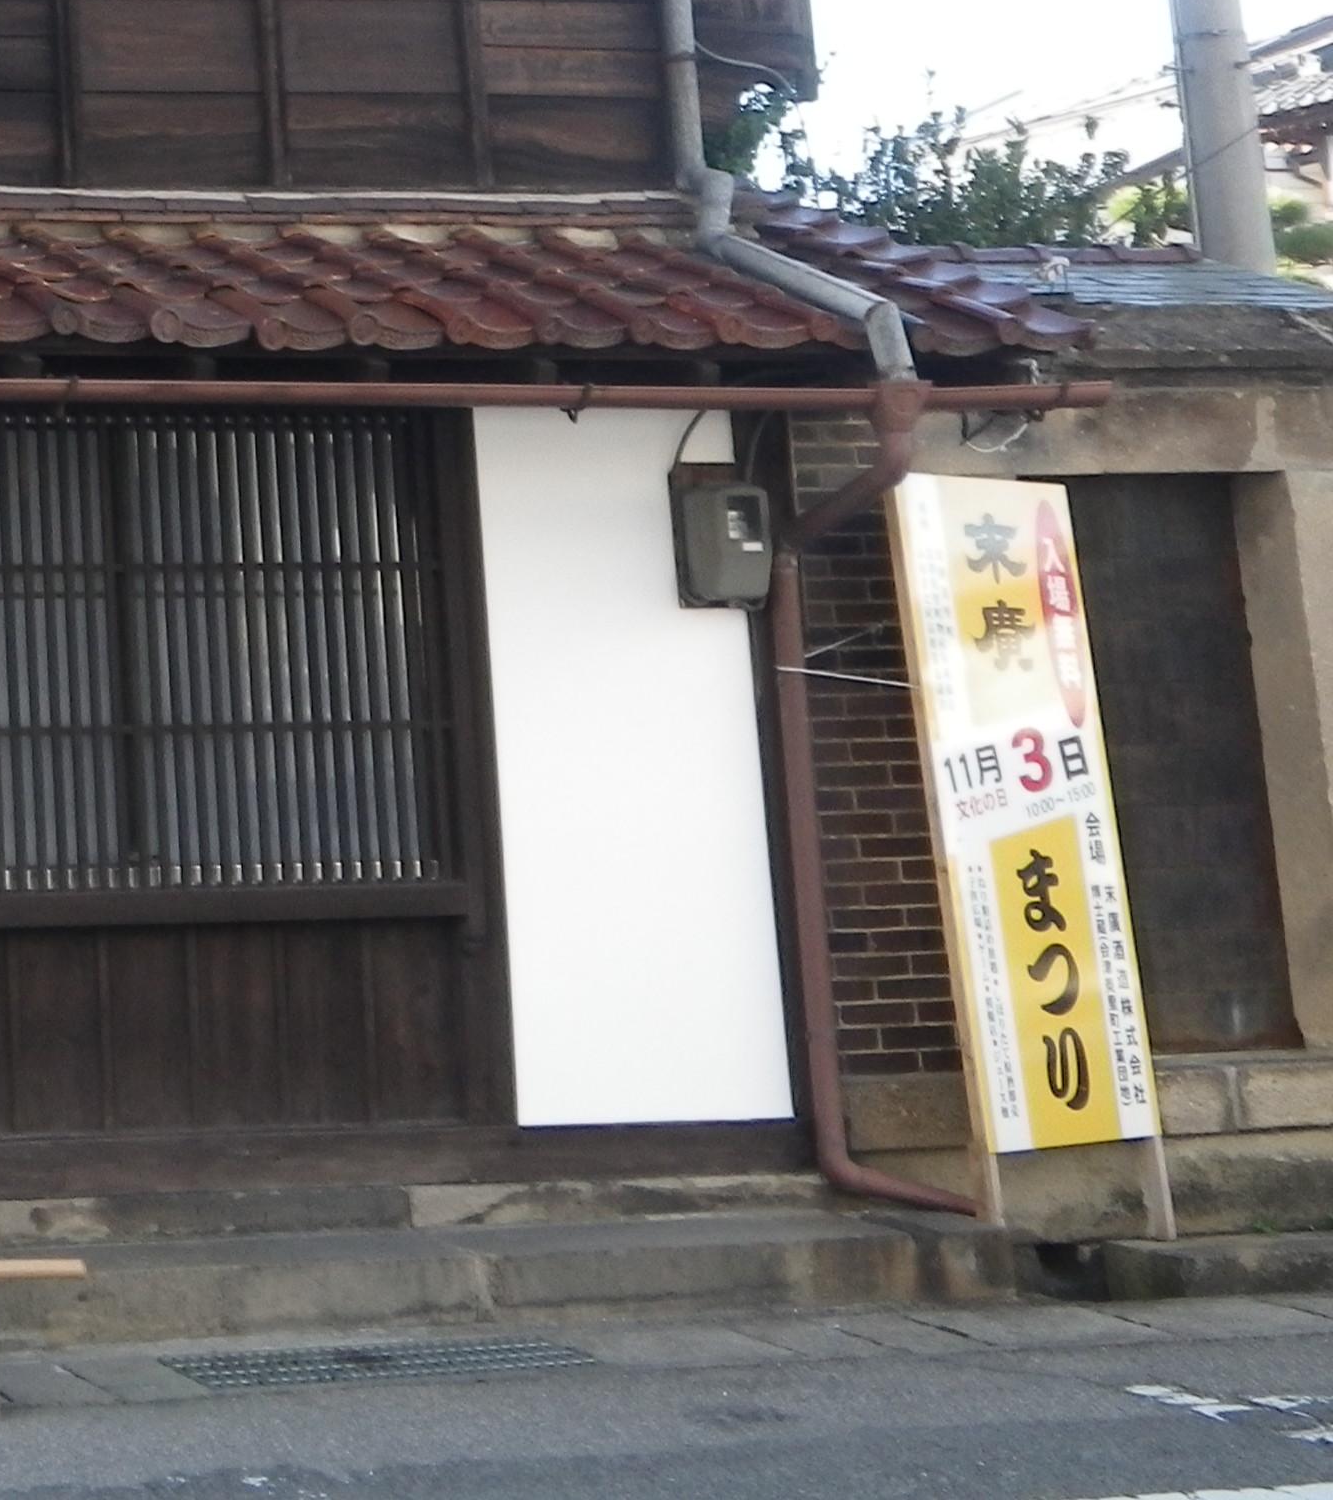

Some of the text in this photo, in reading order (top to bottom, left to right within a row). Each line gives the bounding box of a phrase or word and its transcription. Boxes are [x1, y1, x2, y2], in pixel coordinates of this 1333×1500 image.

[964, 512, 1036, 672] 末廣
[955, 788, 1010, 820] 文化の日
[1084, 812, 1107, 866] 会場
[1015, 849, 1091, 1112] まつり
